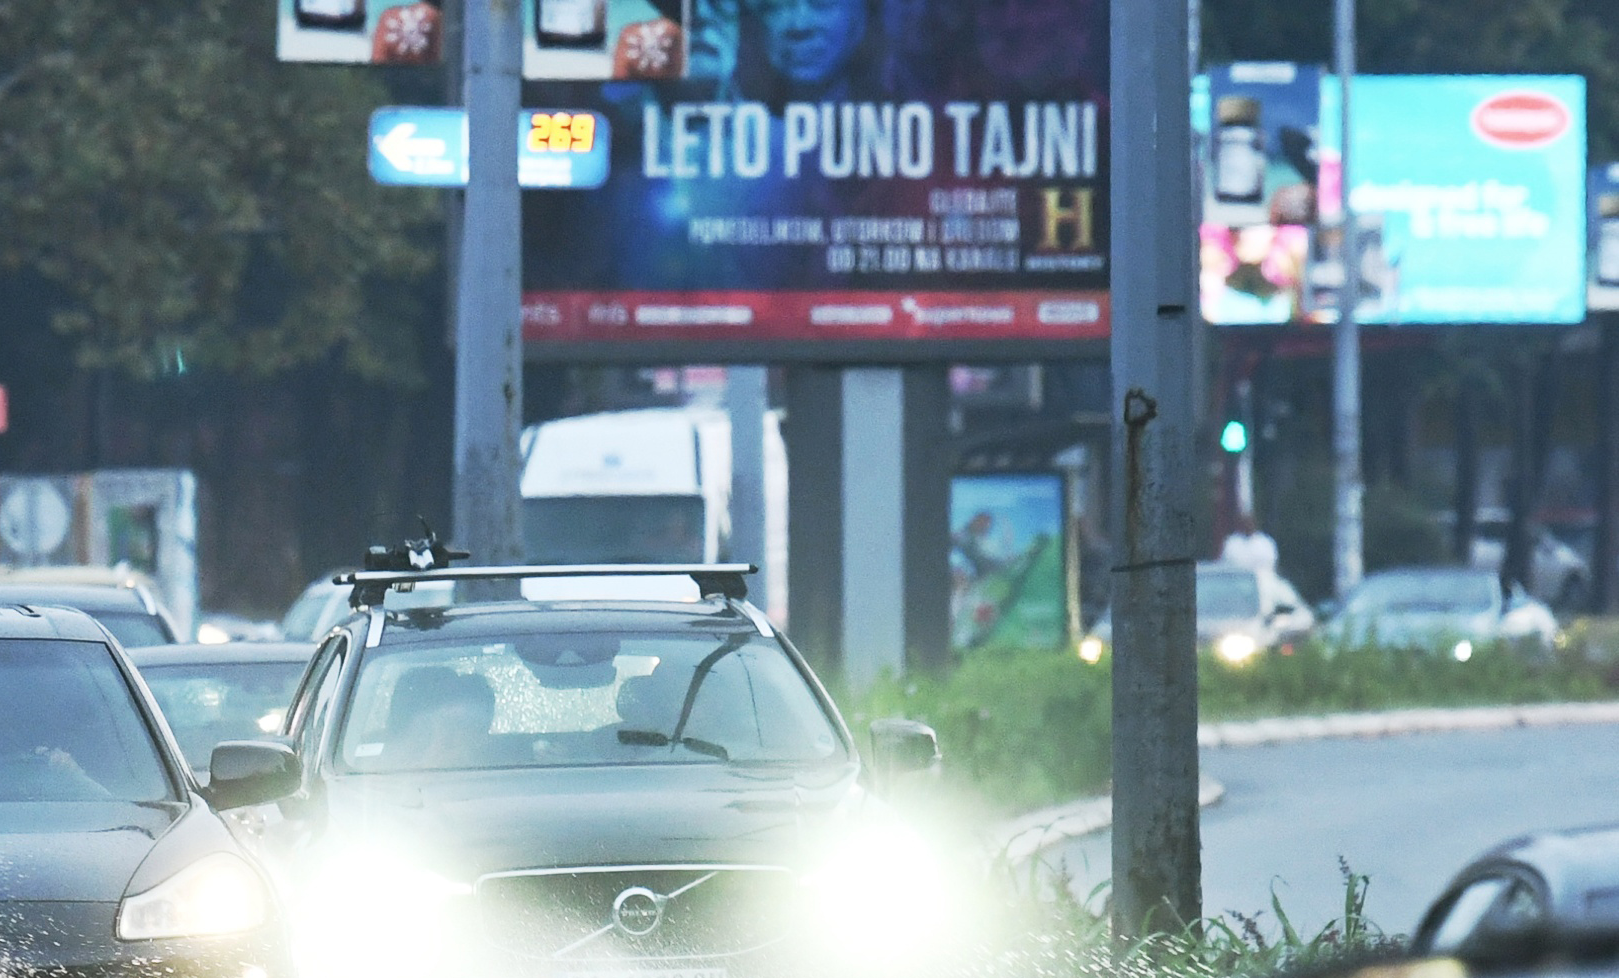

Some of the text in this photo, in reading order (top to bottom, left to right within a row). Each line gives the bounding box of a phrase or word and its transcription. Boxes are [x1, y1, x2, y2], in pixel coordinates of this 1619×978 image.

[528, 112, 595, 152] 269
[642, 102, 1098, 179] LETO PUNO TAJNI
[1036, 187, 1098, 251] H
